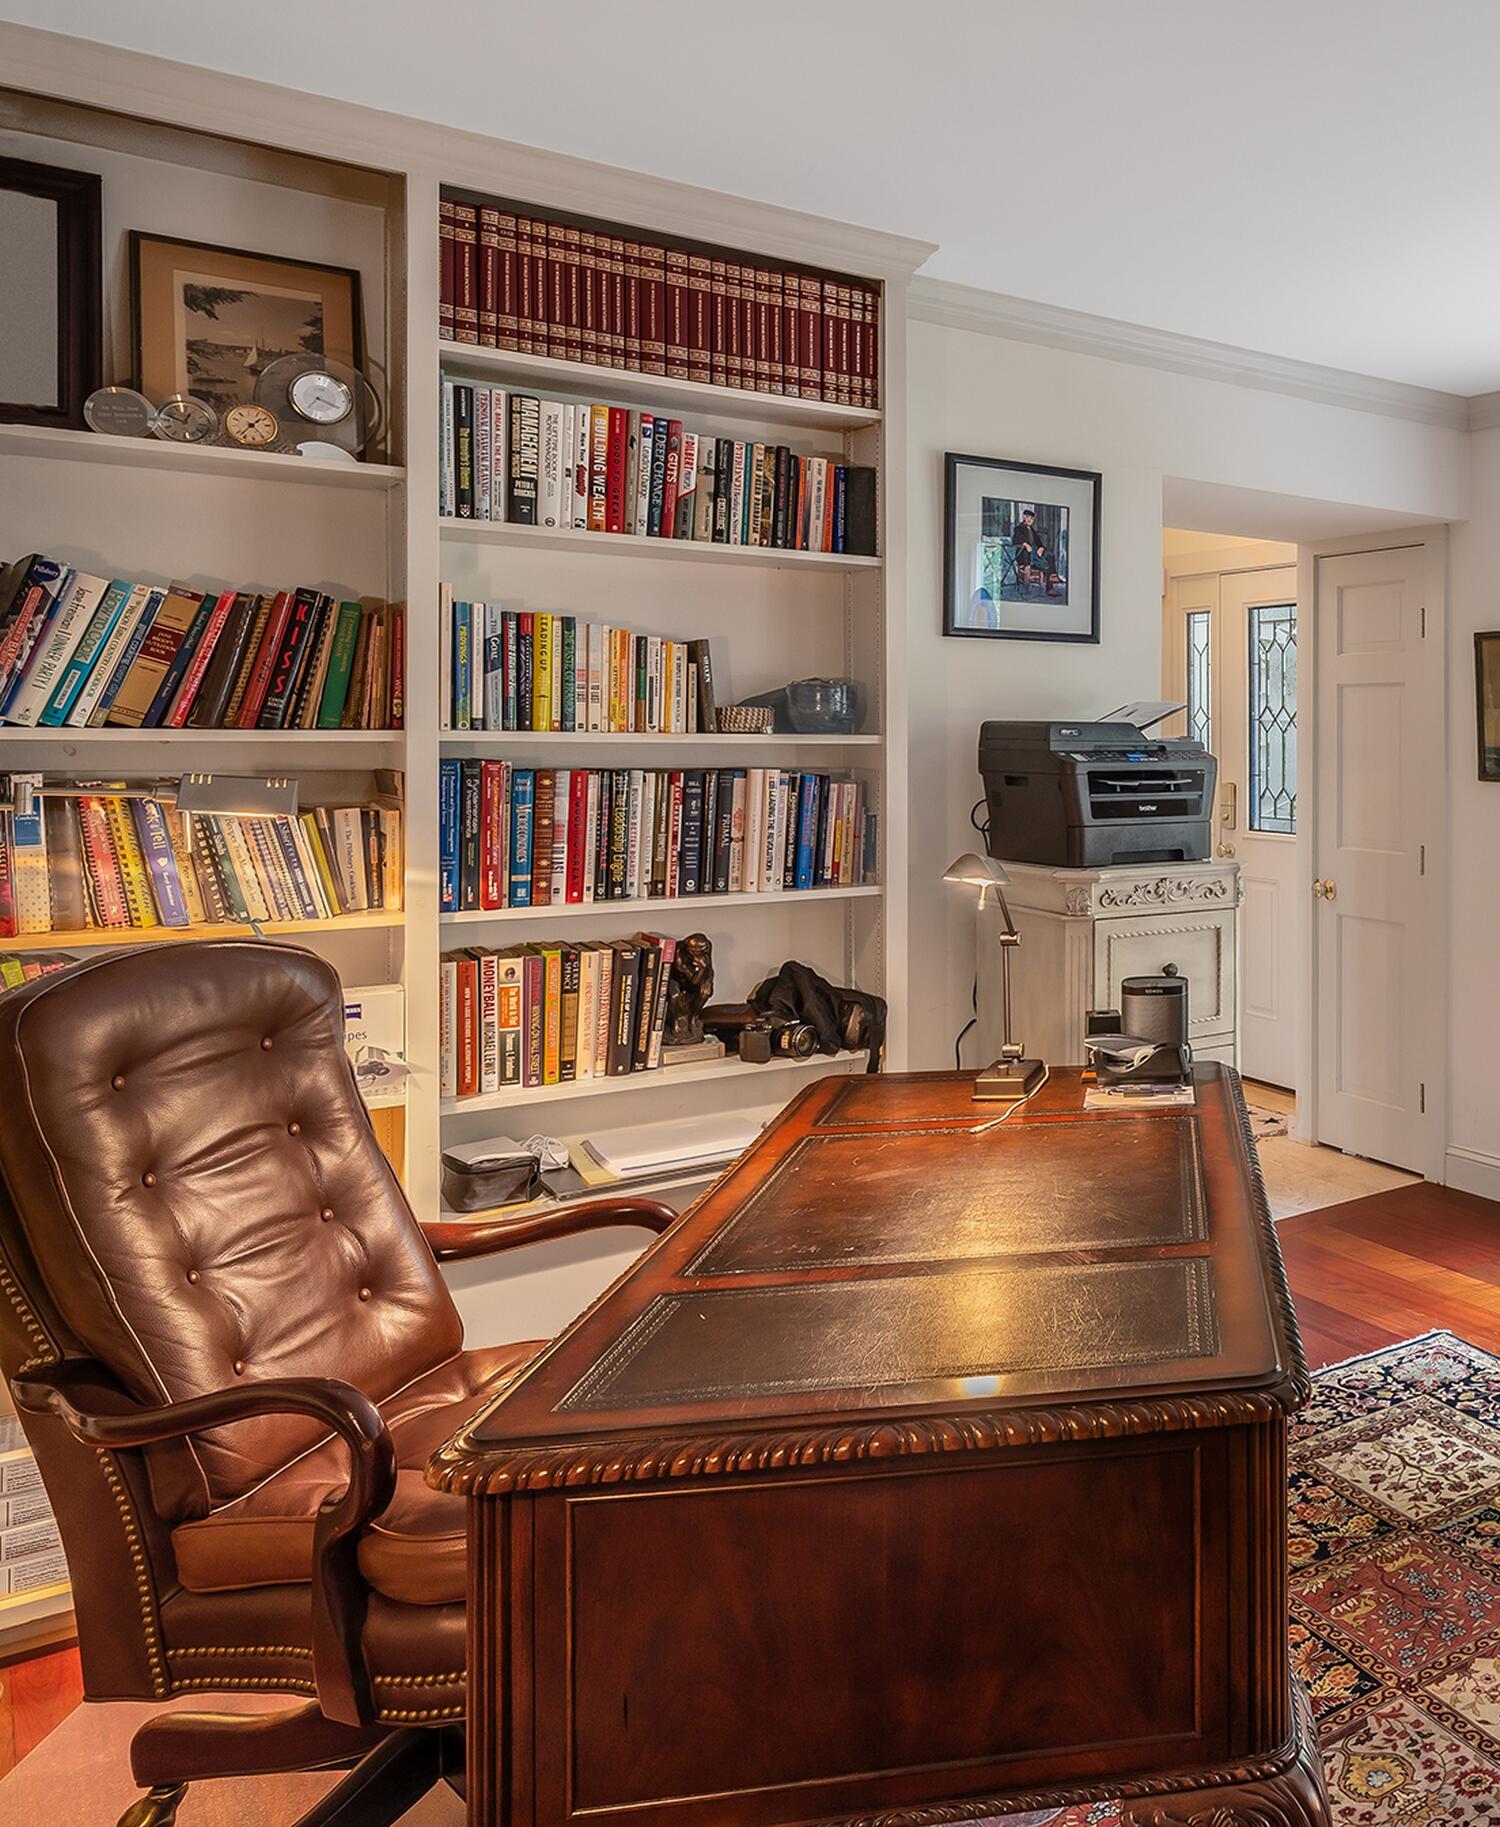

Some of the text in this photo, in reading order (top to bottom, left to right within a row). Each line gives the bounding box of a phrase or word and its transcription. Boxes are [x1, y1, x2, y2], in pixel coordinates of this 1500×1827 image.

[460, 427, 470, 437] The
[521, 397, 538, 480] MANAGEMENT
[593, 418, 606, 520] BUILDING WEALTH
[666, 452, 678, 483] GUTS
[685, 441, 695, 470] DILBERT
[551, 473, 557, 482] OF
[612, 471, 620, 483] TO
[640, 446, 650, 499] Leading Change
[652, 434, 666, 506] DEEP CHANGE
[612, 487, 620, 520] GREAT
[33, 566, 59, 576] Pillsbury
[60, 586, 92, 630] Jane Freiman
[77, 589, 123, 661] HOW TO COOK
[35, 634, 71, 685] DINNER PARTY
[86, 605, 136, 698] WILSON FARM COUNTRY COOKBOOK
[490, 637, 498, 659] GOAL
[540, 659, 547, 671] UP
[394, 678, 402, 698] WINE
[591, 692, 600, 704] LAST
[466, 779, 472, 788] of
[472, 778, 480, 834] Fundamentals
[574, 801, 582, 829] GOOD
[787, 792, 798, 843] Experimentation
[516, 804, 532, 863] MICROECONOMICS
[611, 807, 628, 852] Leadership
[721, 814, 730, 848] PRIMAL
[765, 791, 777, 871] LEADING THE REVOLUTION
[213, 834, 226, 855] Salads
[346, 842, 355, 869] Pillsbury
[655, 833, 666, 862] Investing
[572, 853, 580, 886] GREAT
[610, 854, 625, 882] Engine
[349, 871, 357, 901] Cookbook
[670, 879, 676, 889] UP
[563, 962, 572, 990] SPENCE
[509, 997, 518, 1010] World
[510, 987, 518, 996] The
[482, 960, 495, 1076] MONEYBALL MICHAEL LEWIS
[509, 1016, 517, 1025] Flat
[531, 1005, 539, 1028] WINNING
[622, 1012, 630, 1045] LEADERSHIP
[506, 1034, 516, 1051] Thomas
[531, 1038, 539, 1053] WALL
[505, 1057, 515, 1078] Friedman
[530, 1055, 539, 1075] STREET
